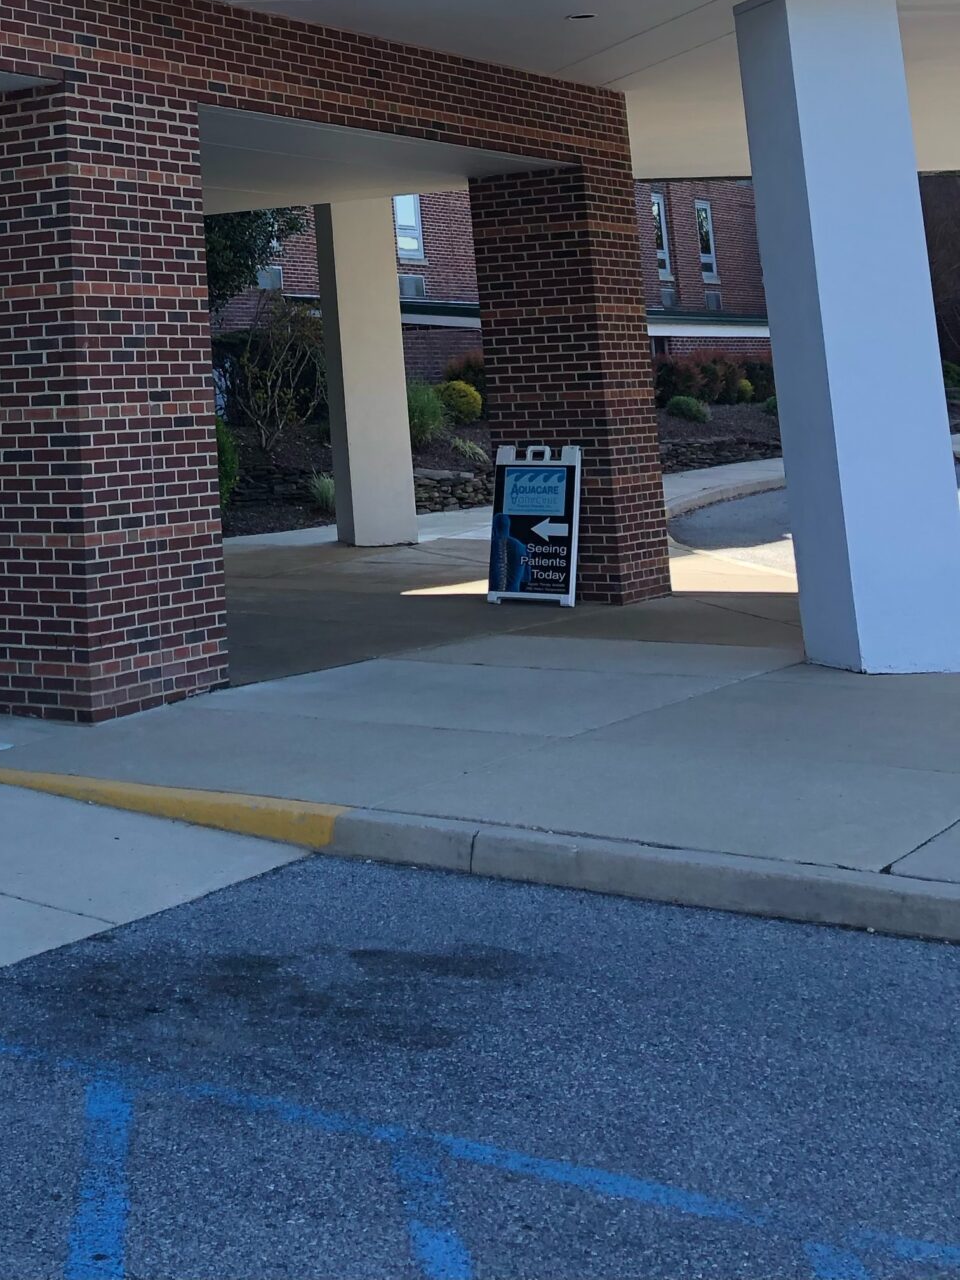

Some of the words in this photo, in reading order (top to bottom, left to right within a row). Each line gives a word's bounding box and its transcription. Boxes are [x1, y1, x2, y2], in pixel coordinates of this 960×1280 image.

[510, 483, 559, 496] AQUACARE
[526, 543, 568, 556] Seeing
[520, 556, 567, 568] Patients
[532, 569, 566, 582] Today
